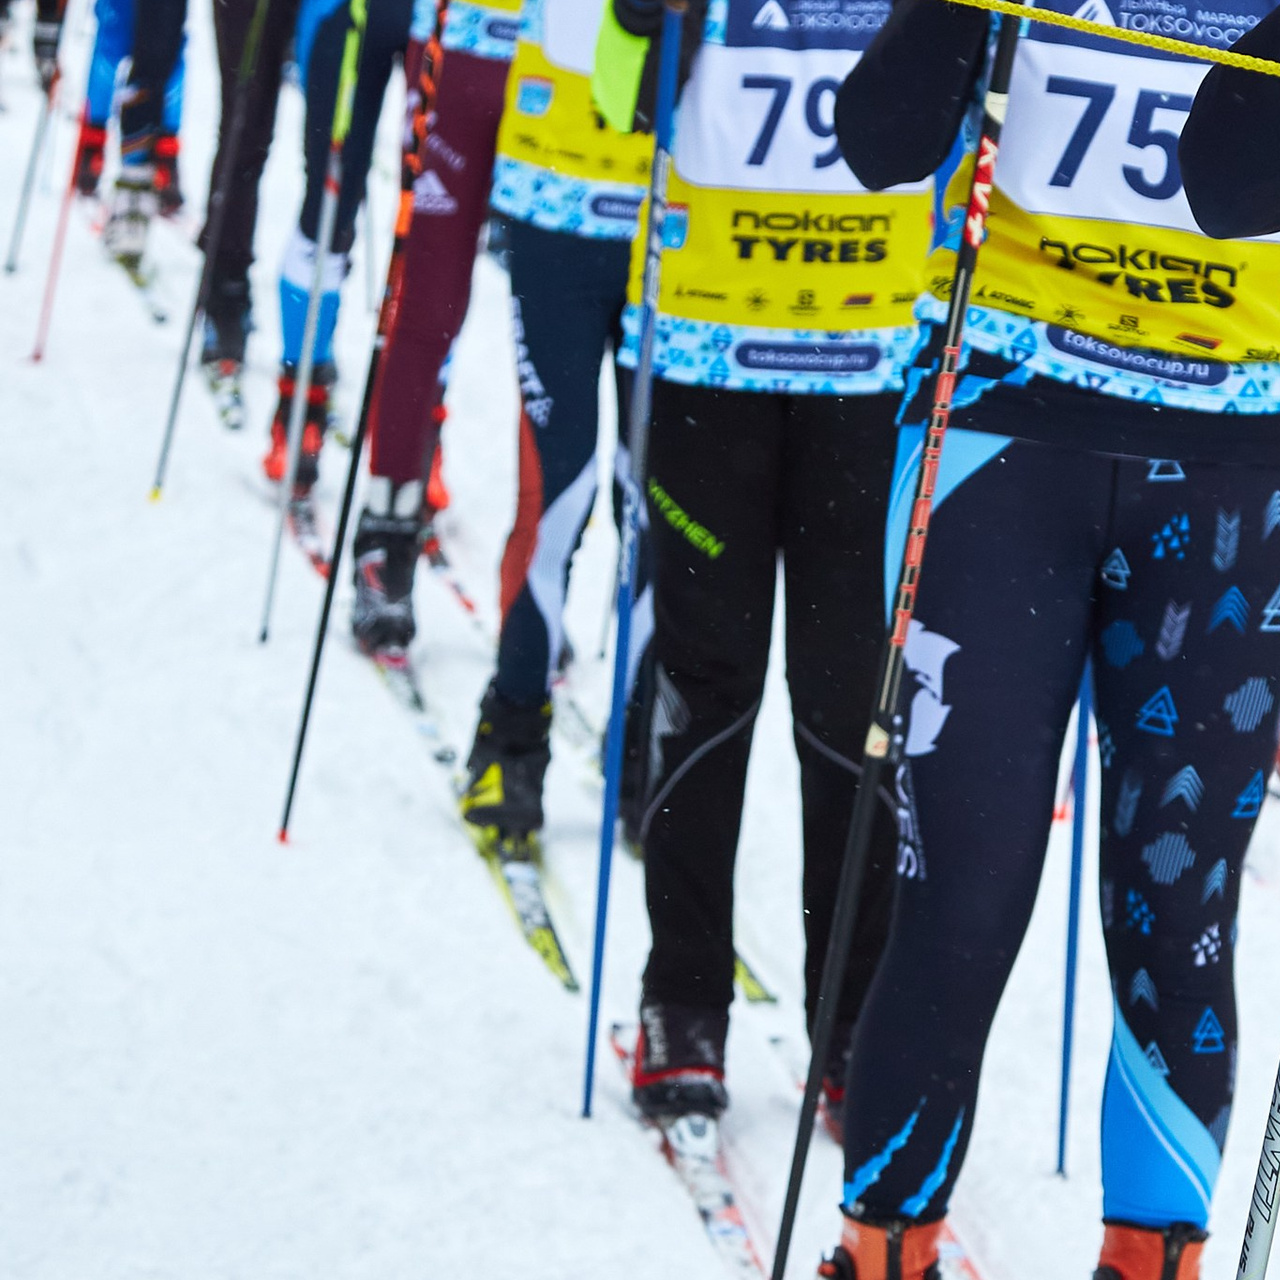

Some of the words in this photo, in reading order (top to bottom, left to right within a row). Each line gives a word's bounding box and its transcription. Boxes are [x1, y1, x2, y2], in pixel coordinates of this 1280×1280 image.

[1195, 9, 1262, 27] МАРАФО
[731, 234, 888, 263] TYRES
[1063, 329, 1210, 379] toksovocup.ru
